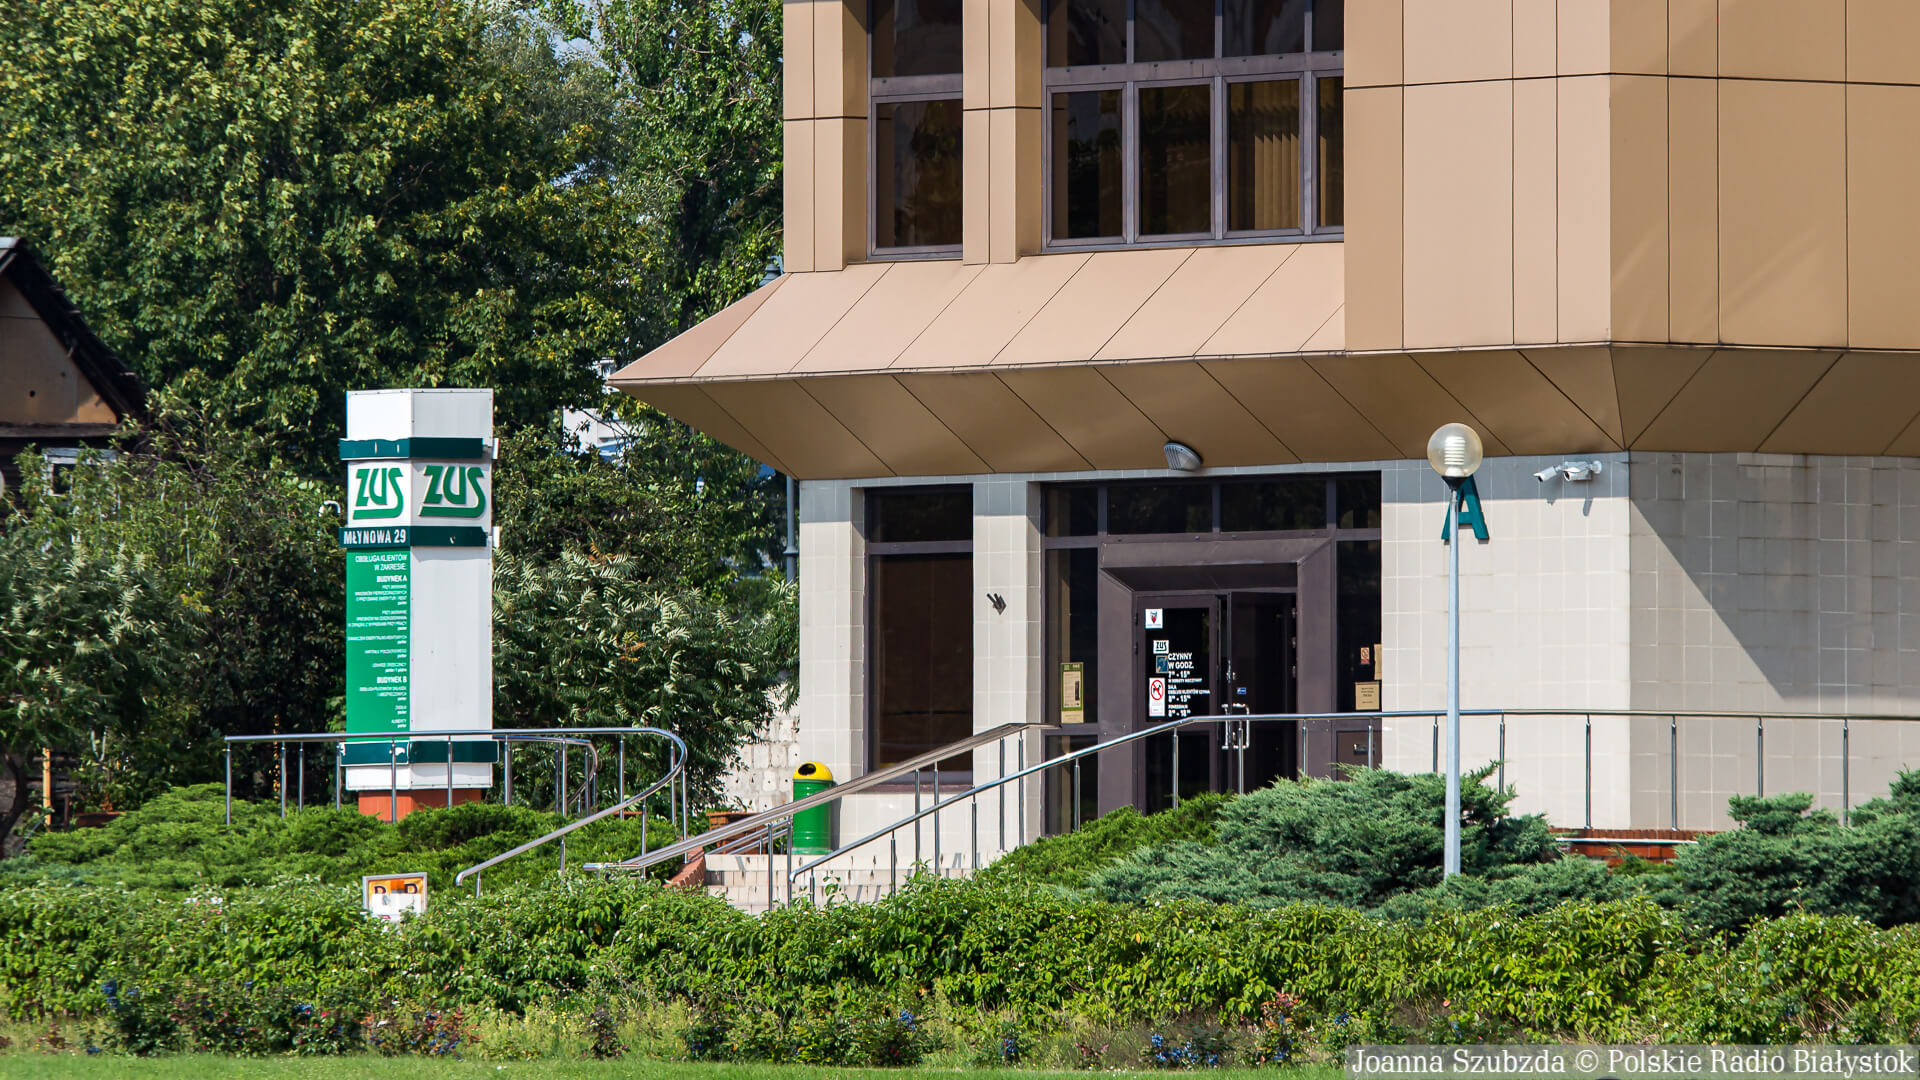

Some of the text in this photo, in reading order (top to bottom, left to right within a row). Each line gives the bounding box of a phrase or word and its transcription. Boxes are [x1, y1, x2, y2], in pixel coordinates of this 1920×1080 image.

[353, 467, 404, 520] ZUS
[418, 465, 486, 518] ZUS
[1441, 473, 1490, 540] A
[343, 528, 407, 545] MŁYNOWA 29
[1156, 641, 1167, 652] ZUS
[1168, 652, 1192, 661] CZYNNY
[1168, 661, 1194, 670] W GODZ.
